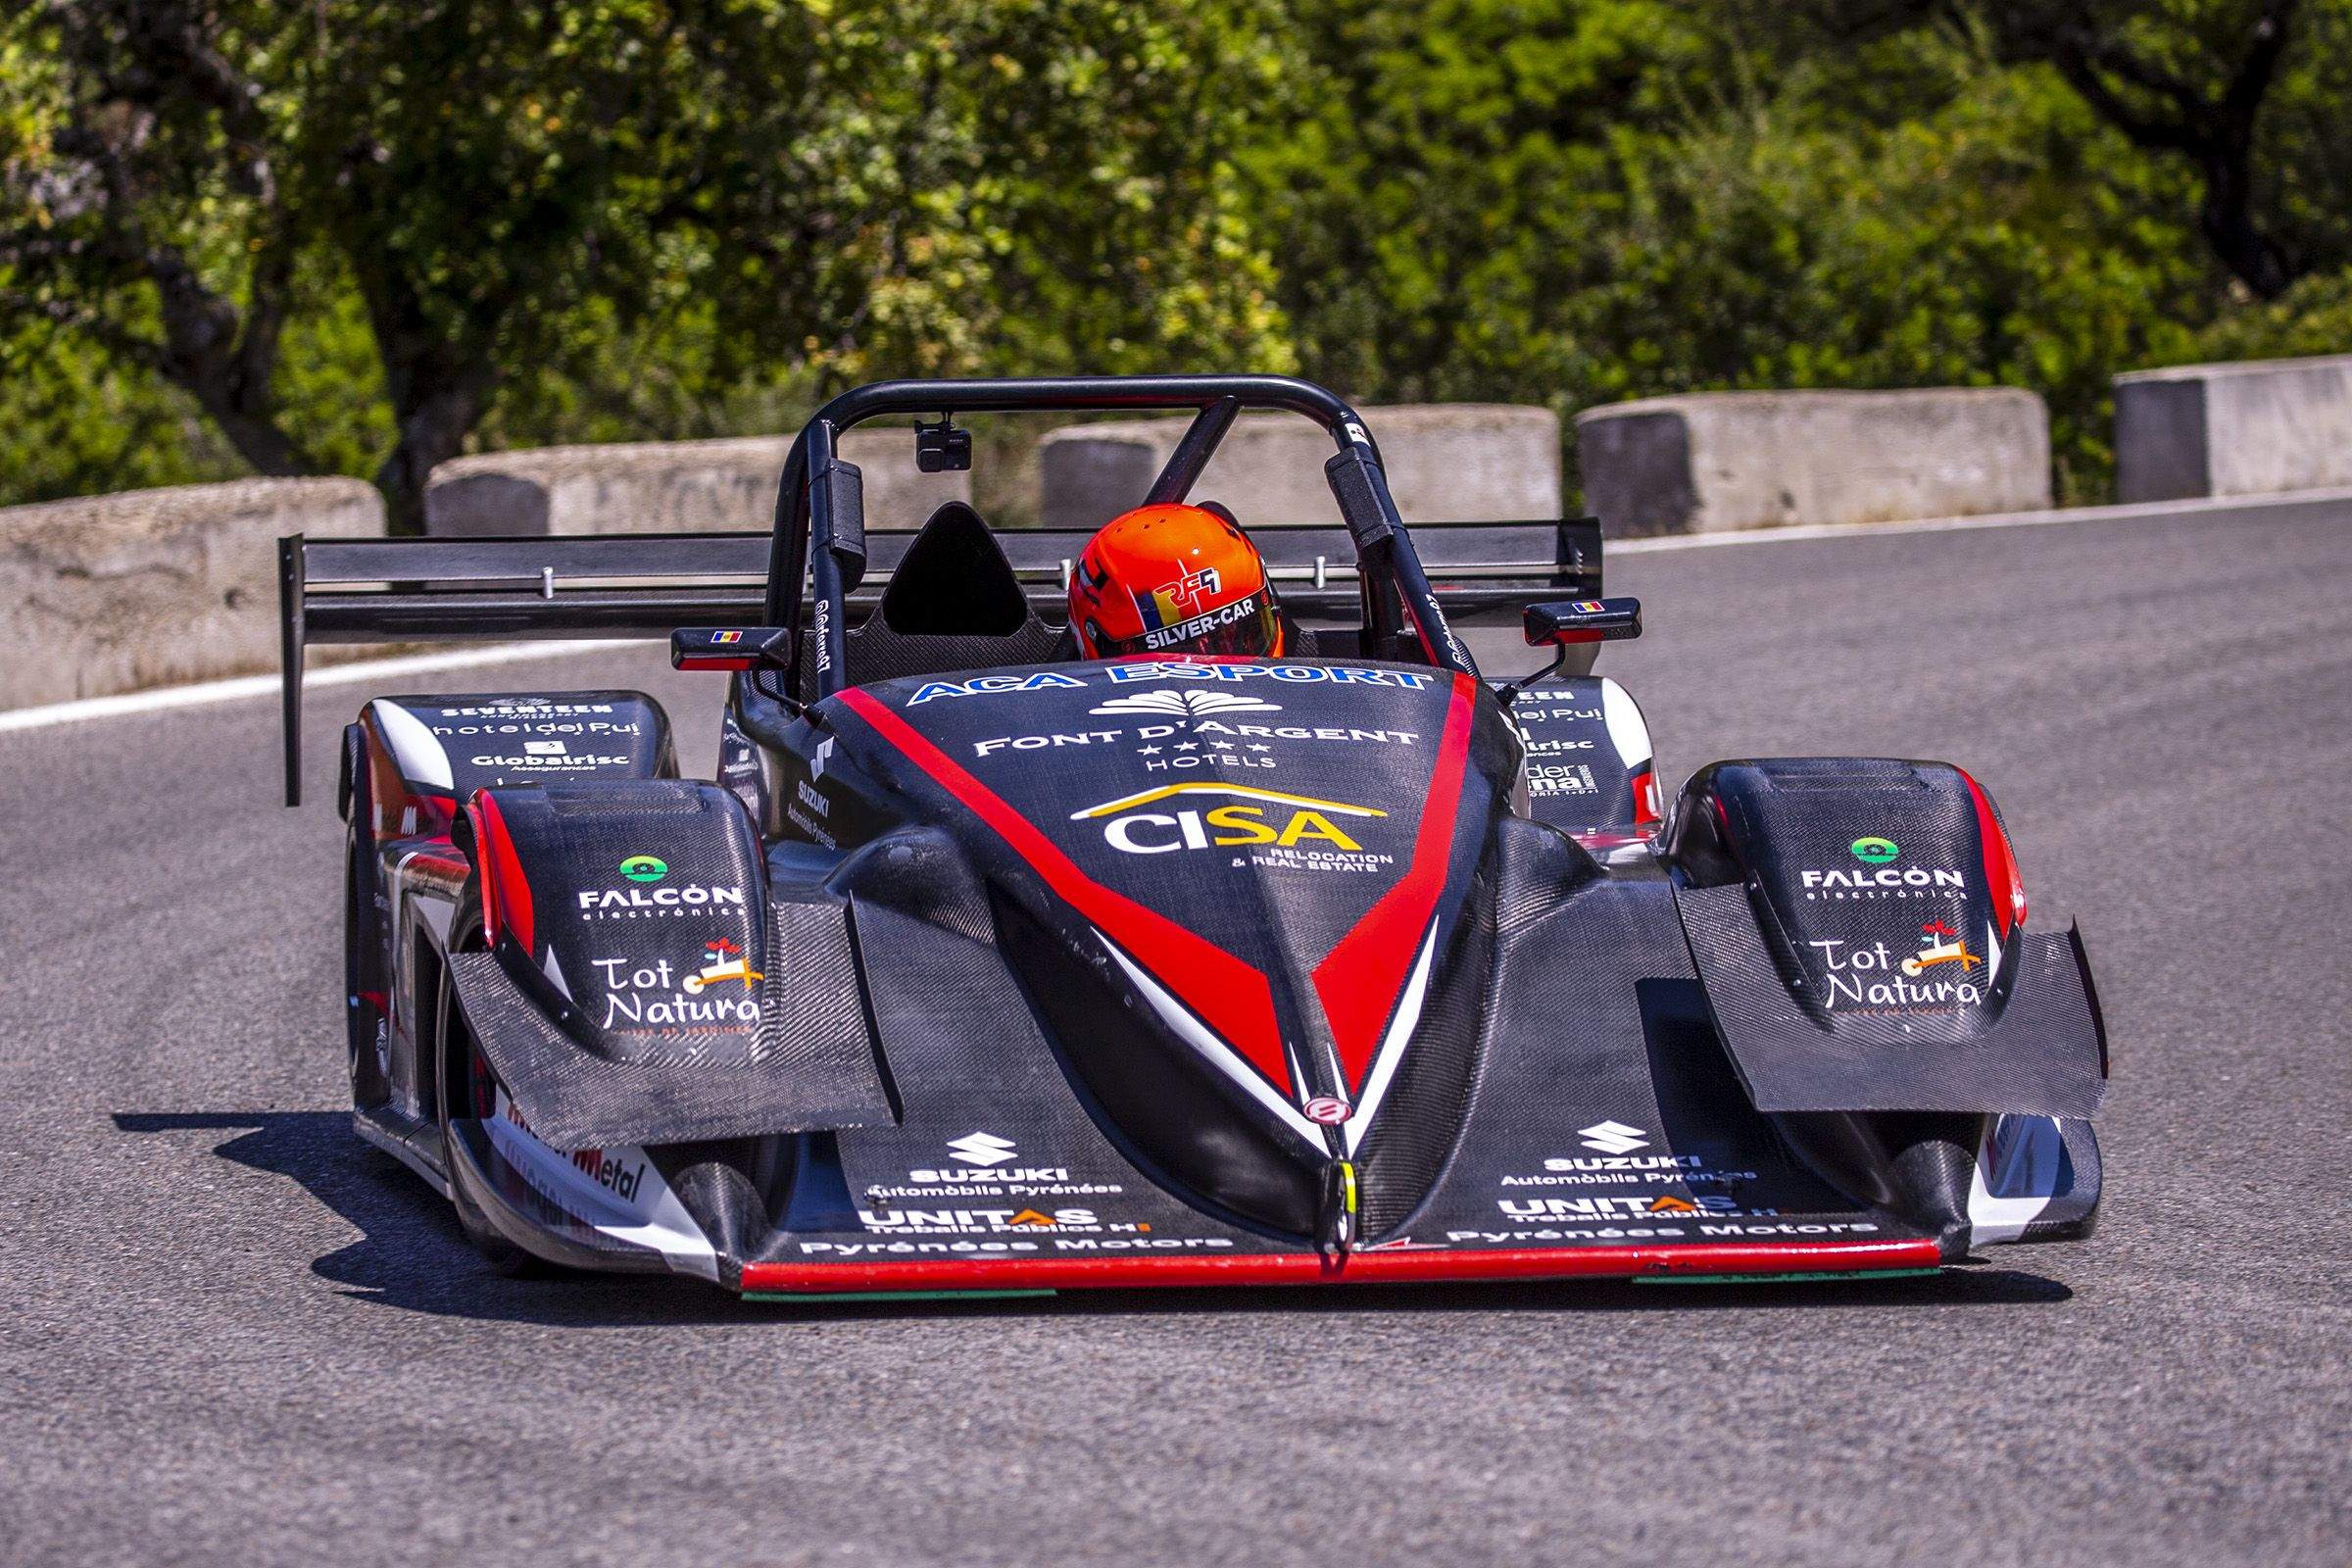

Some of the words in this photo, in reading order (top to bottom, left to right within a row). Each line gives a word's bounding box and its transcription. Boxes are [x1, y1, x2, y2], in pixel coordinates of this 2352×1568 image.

[1145, 598, 1255, 651] SILVER-CAR
[906, 672, 1088, 708] ACA
[1104, 662, 1434, 691] ESPORT
[441, 705, 613, 717] SEVENTEEN
[432, 722, 533, 736] hotel
[973, 729, 1123, 758] FONT
[1137, 719, 1419, 745] D'ARGENT
[471, 755, 630, 766] Globalrisc
[1146, 754, 1277, 773] HOTELS
[1527, 764, 1575, 779] der
[798, 779, 830, 818] SUZUKI
[1103, 806, 1363, 855] CISA
[1231, 858, 1247, 868] &
[1251, 855, 1302, 869] REAL
[1306, 860, 1379, 873] ESTATE
[1270, 848, 1395, 865] RELOCATION
[1808, 939, 1891, 971] Tot
[590, 958, 674, 990] Tot
[1825, 972, 1983, 1009] Natura
[602, 991, 761, 1030] Natura
[1544, 1154, 1703, 1172] SUZUKI
[908, 1167, 1070, 1184] SUZUKI
[1007, 1183, 1124, 1197] Pyrénées
[1497, 1195, 1739, 1216] UNITAS
[858, 1208, 1099, 1227] UNITAS
[1446, 1227, 1685, 1244] Pyrénées
[1698, 1222, 1880, 1237] Motors
[798, 1239, 1040, 1255] Pyrénées
[1054, 1237, 1235, 1250] Motors
